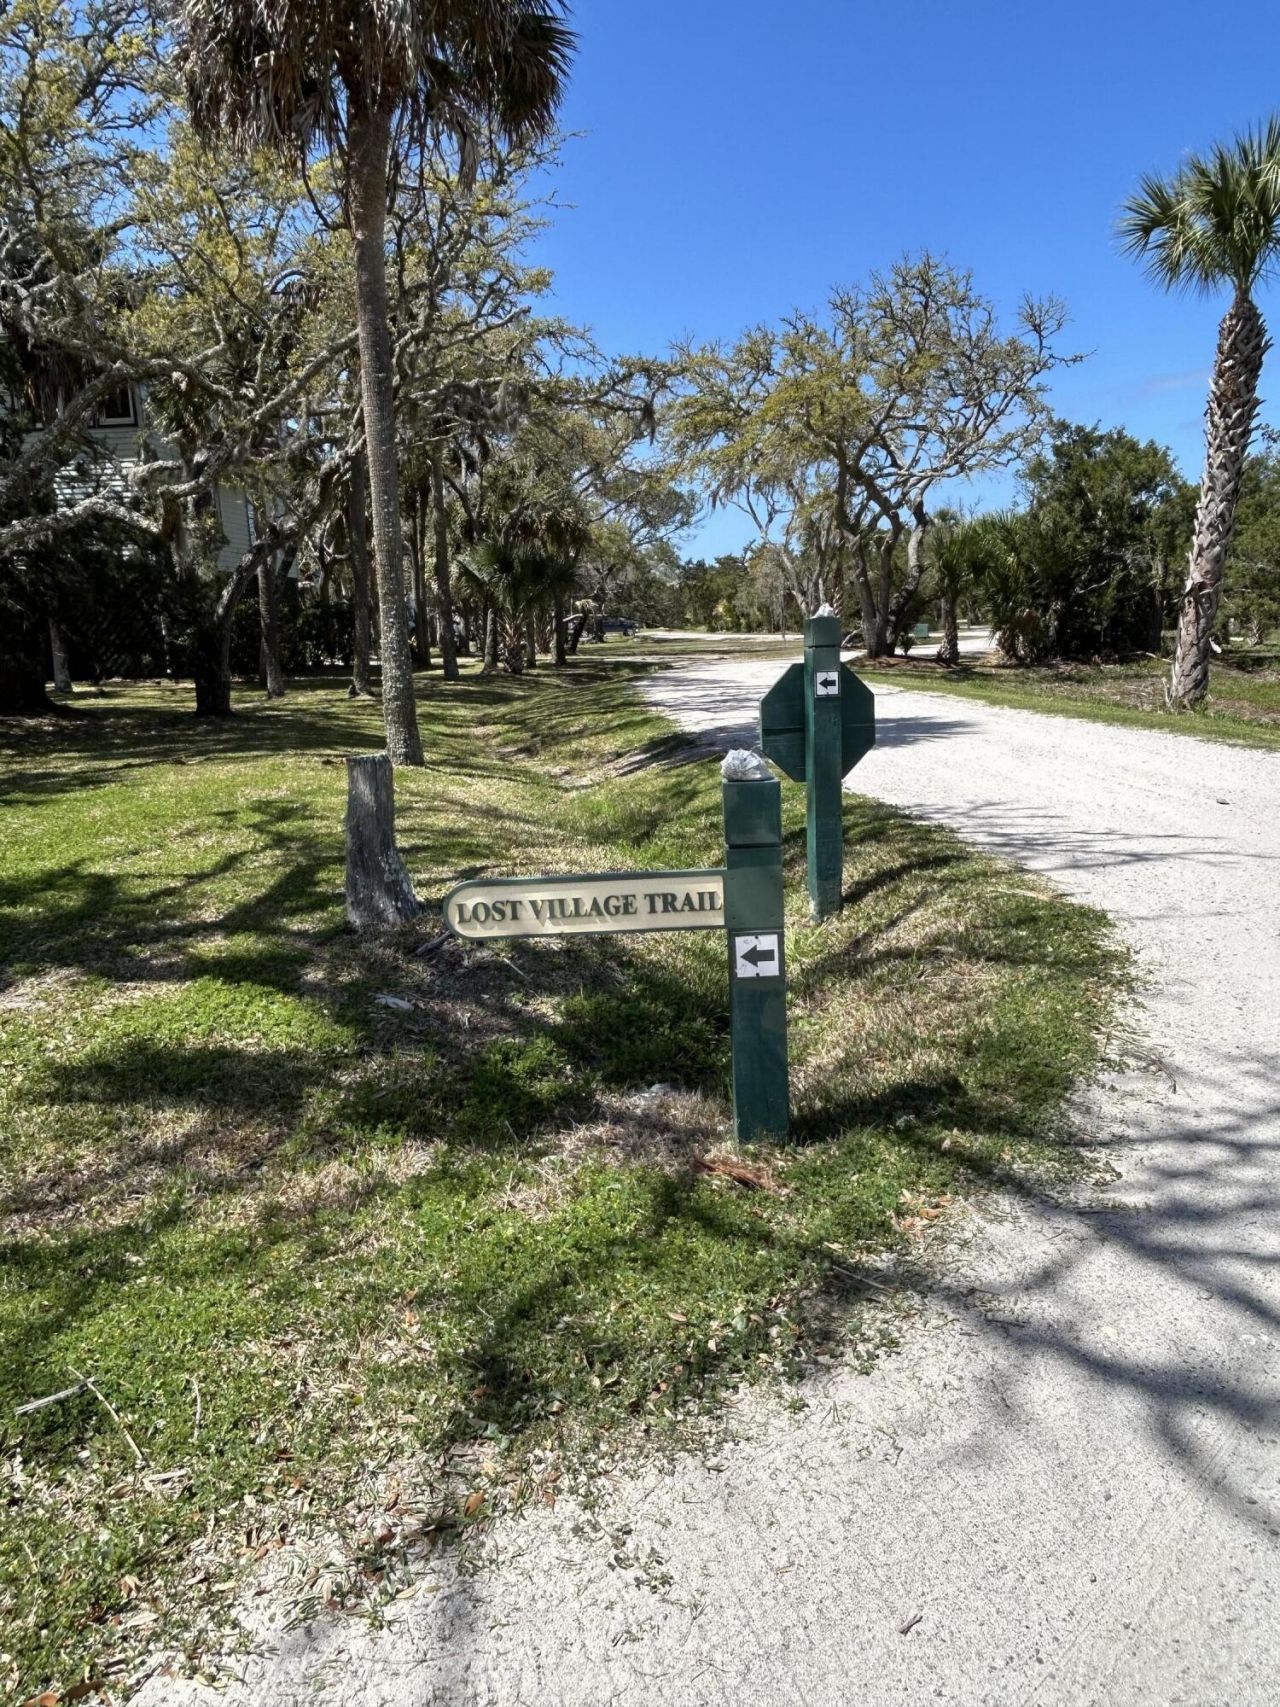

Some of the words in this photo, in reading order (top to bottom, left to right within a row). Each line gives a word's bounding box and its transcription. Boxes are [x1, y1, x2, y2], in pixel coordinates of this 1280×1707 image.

[456, 900, 523, 924] LOST
[529, 894, 637, 921] VILLAGE
[644, 891, 722, 914] TRAIL
